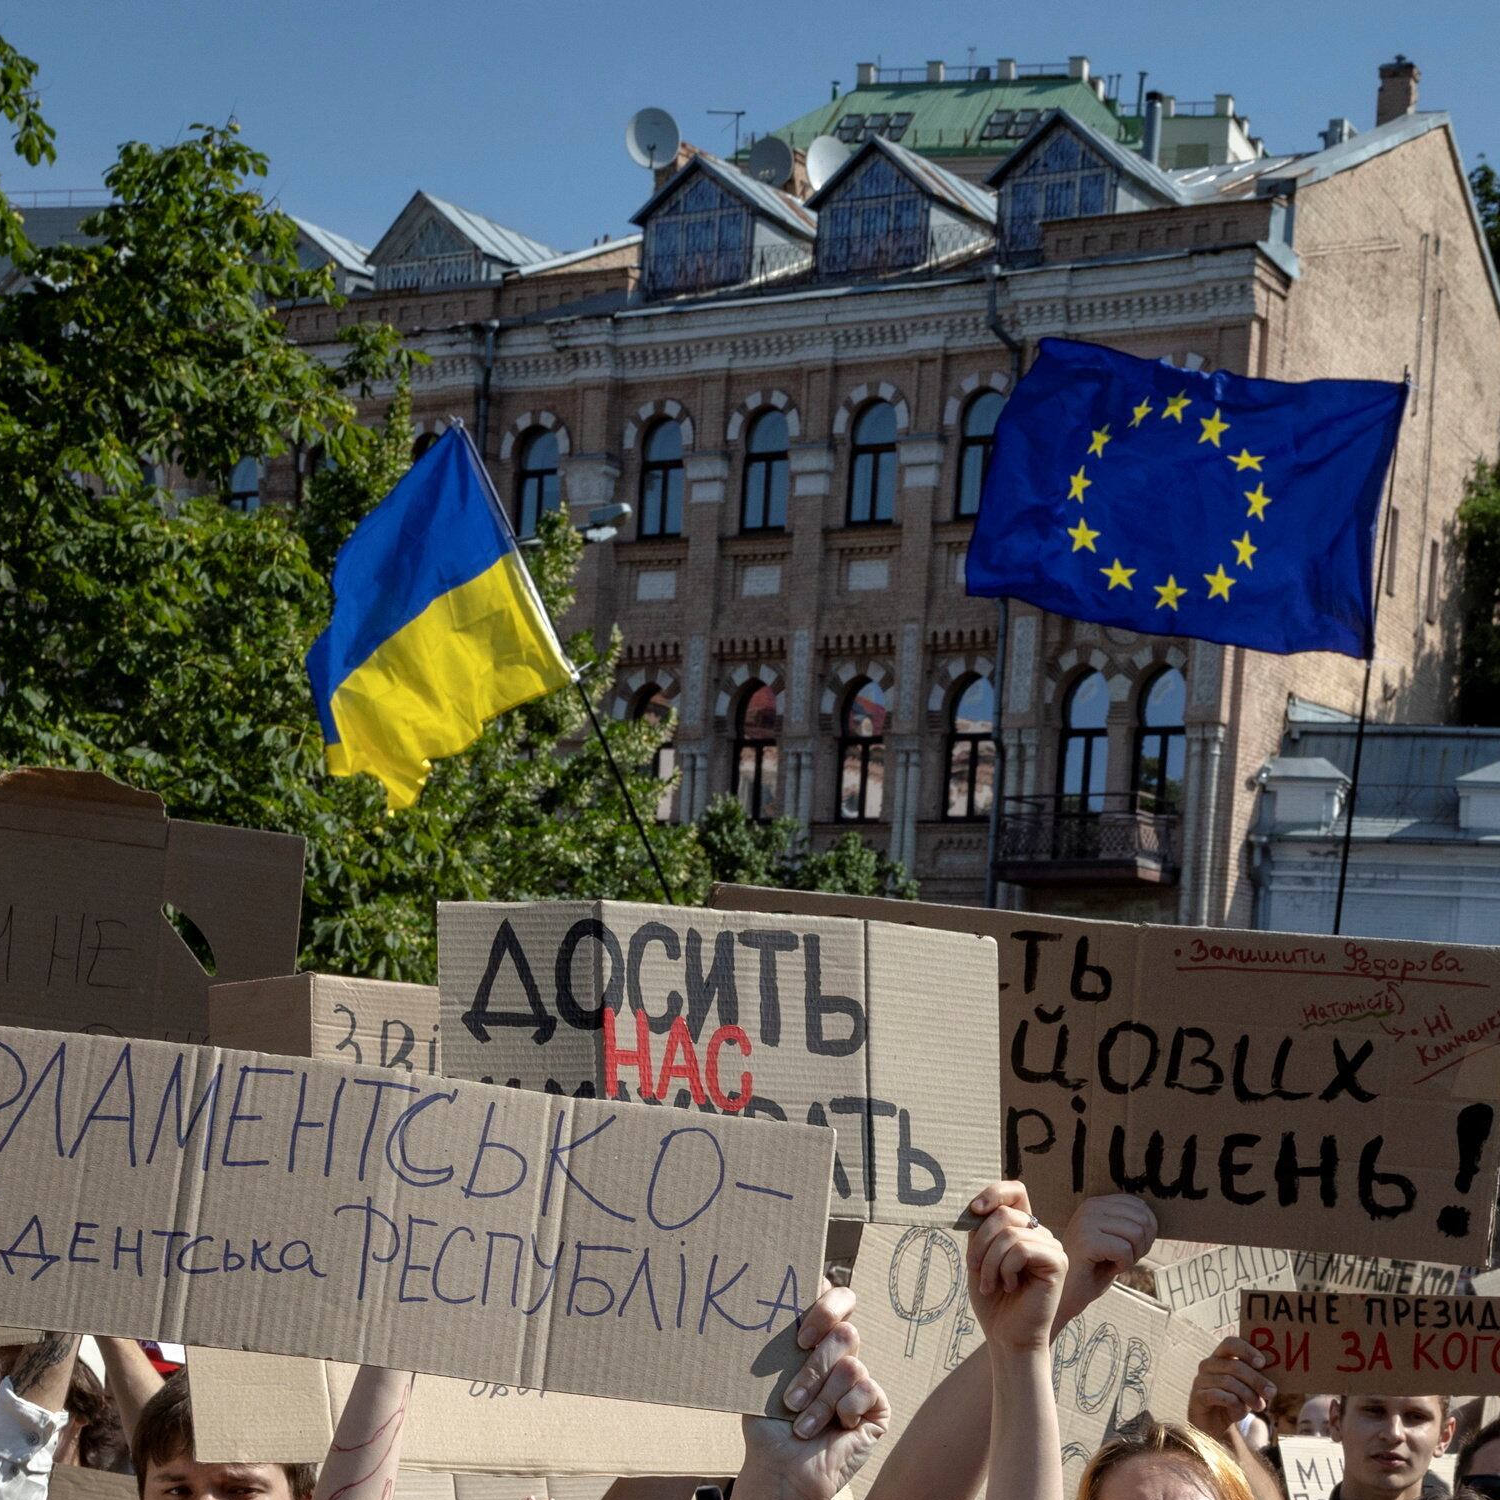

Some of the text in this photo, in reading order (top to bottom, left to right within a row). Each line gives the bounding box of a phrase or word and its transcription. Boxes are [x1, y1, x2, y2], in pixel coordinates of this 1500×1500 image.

[47, 911, 135, 992] НЕ
[462, 918, 867, 1056] ДОСИТЬ
[603, 1006, 752, 1110] НАС
[334, 1196, 805, 1334] РЕСПУБЛІКА
[1246, 1293, 1341, 1325] ПАНЕ
[1336, 1331, 1393, 1373] ЗА
